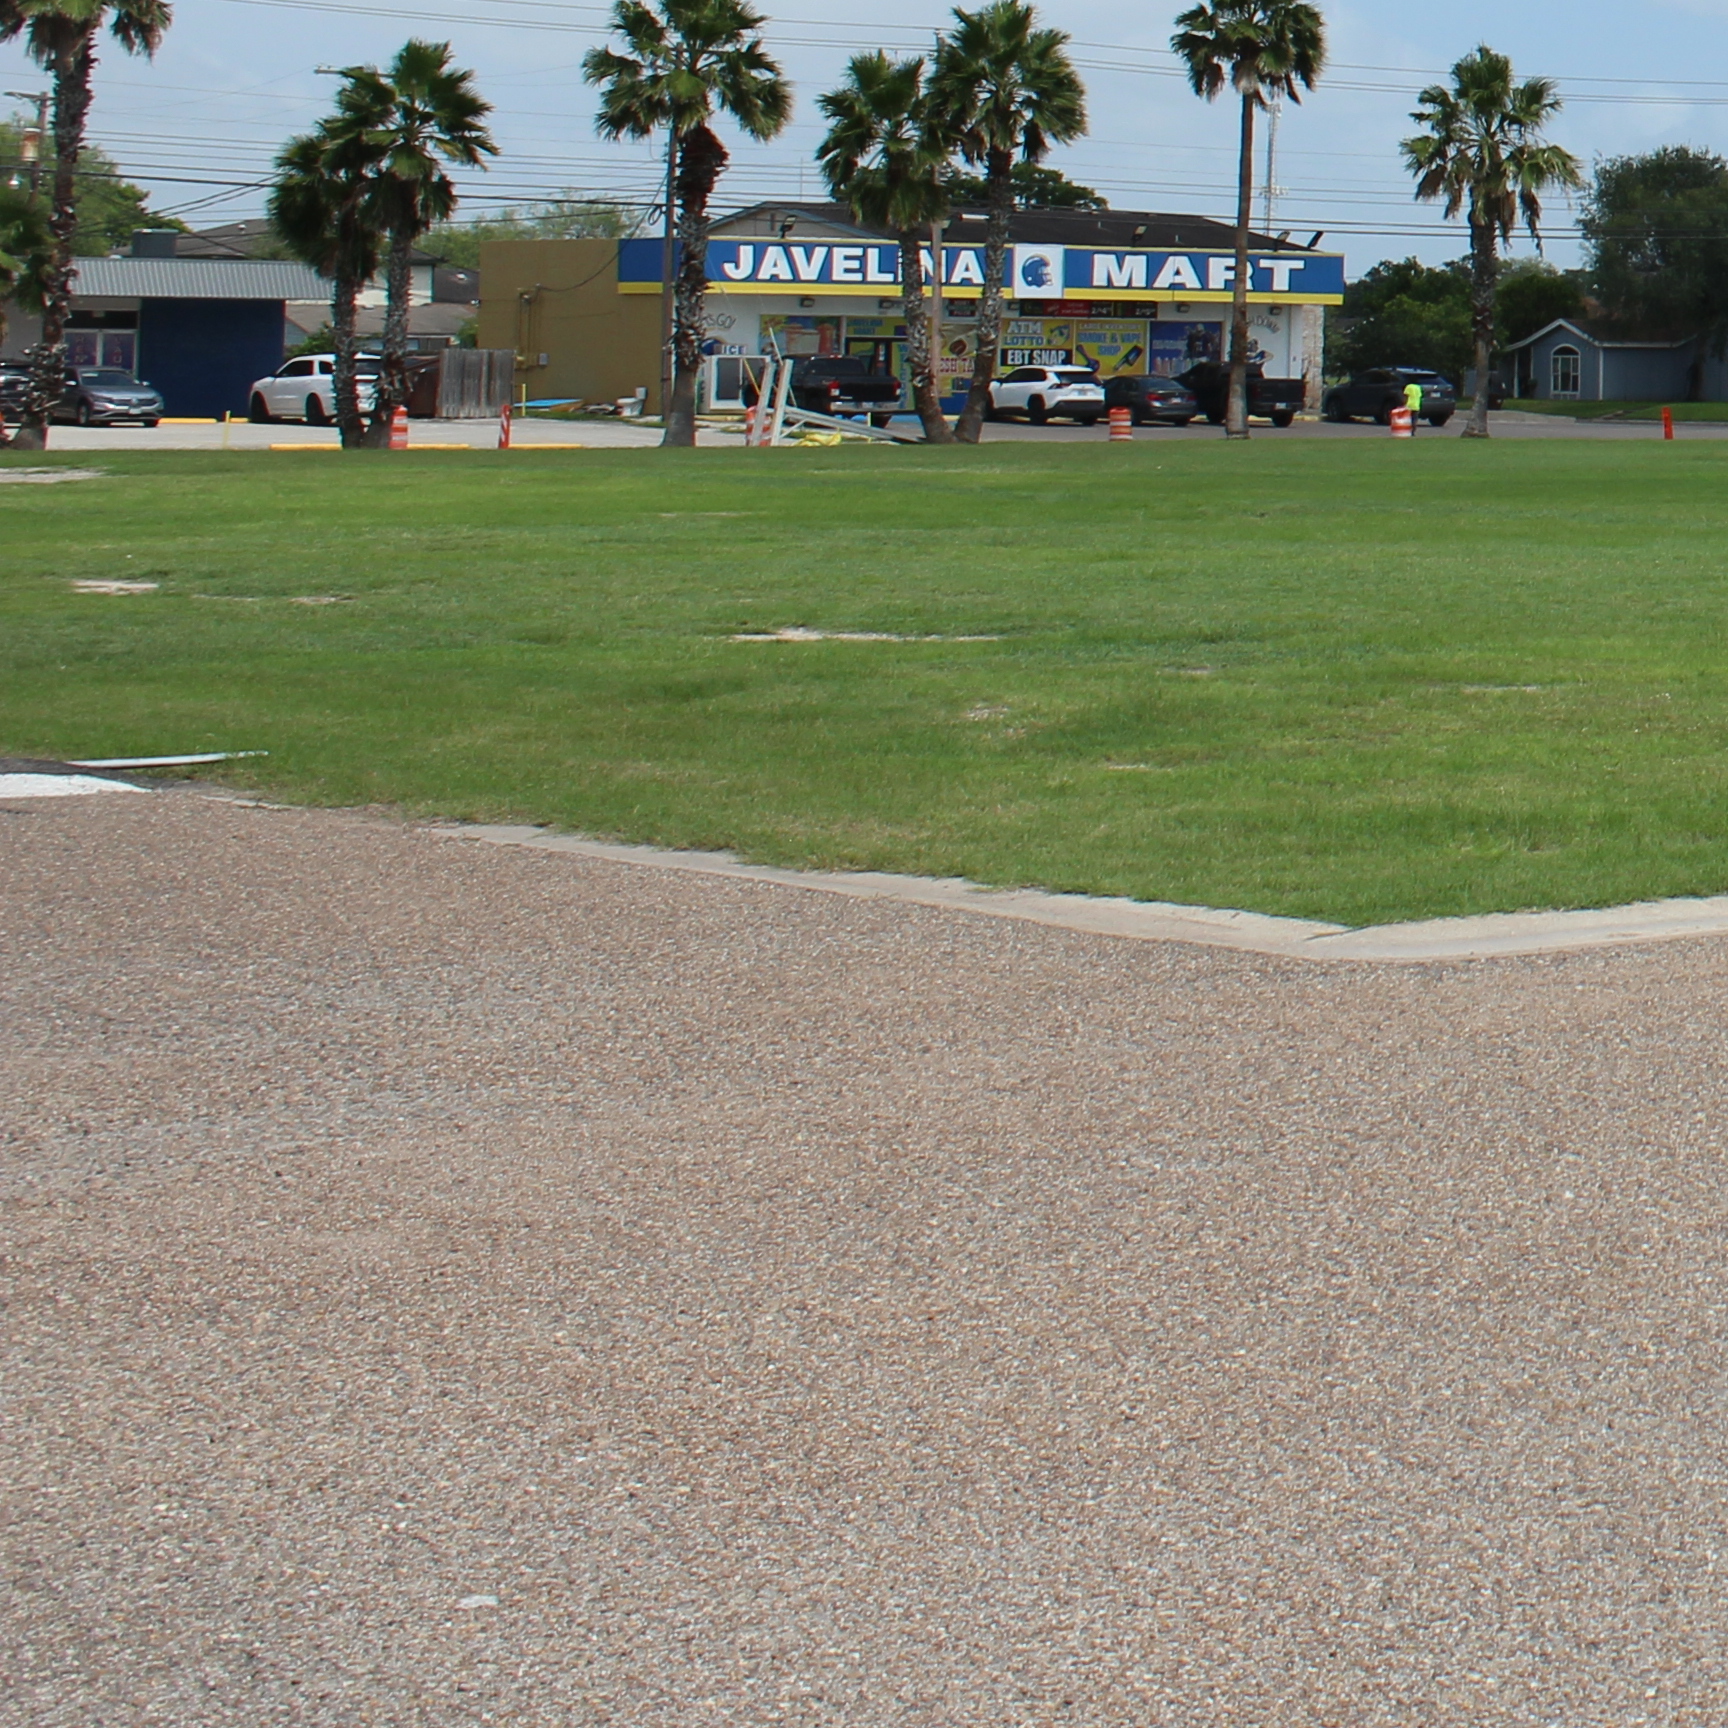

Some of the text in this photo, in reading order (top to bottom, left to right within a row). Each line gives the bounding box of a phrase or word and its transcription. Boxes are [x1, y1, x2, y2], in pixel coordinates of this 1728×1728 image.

[1092, 252, 1305, 291] MART
[1008, 320, 1042, 334] ATM
[1004, 335, 1044, 346] LOTTO
[1007, 349, 1066, 365] EBT SNAP
